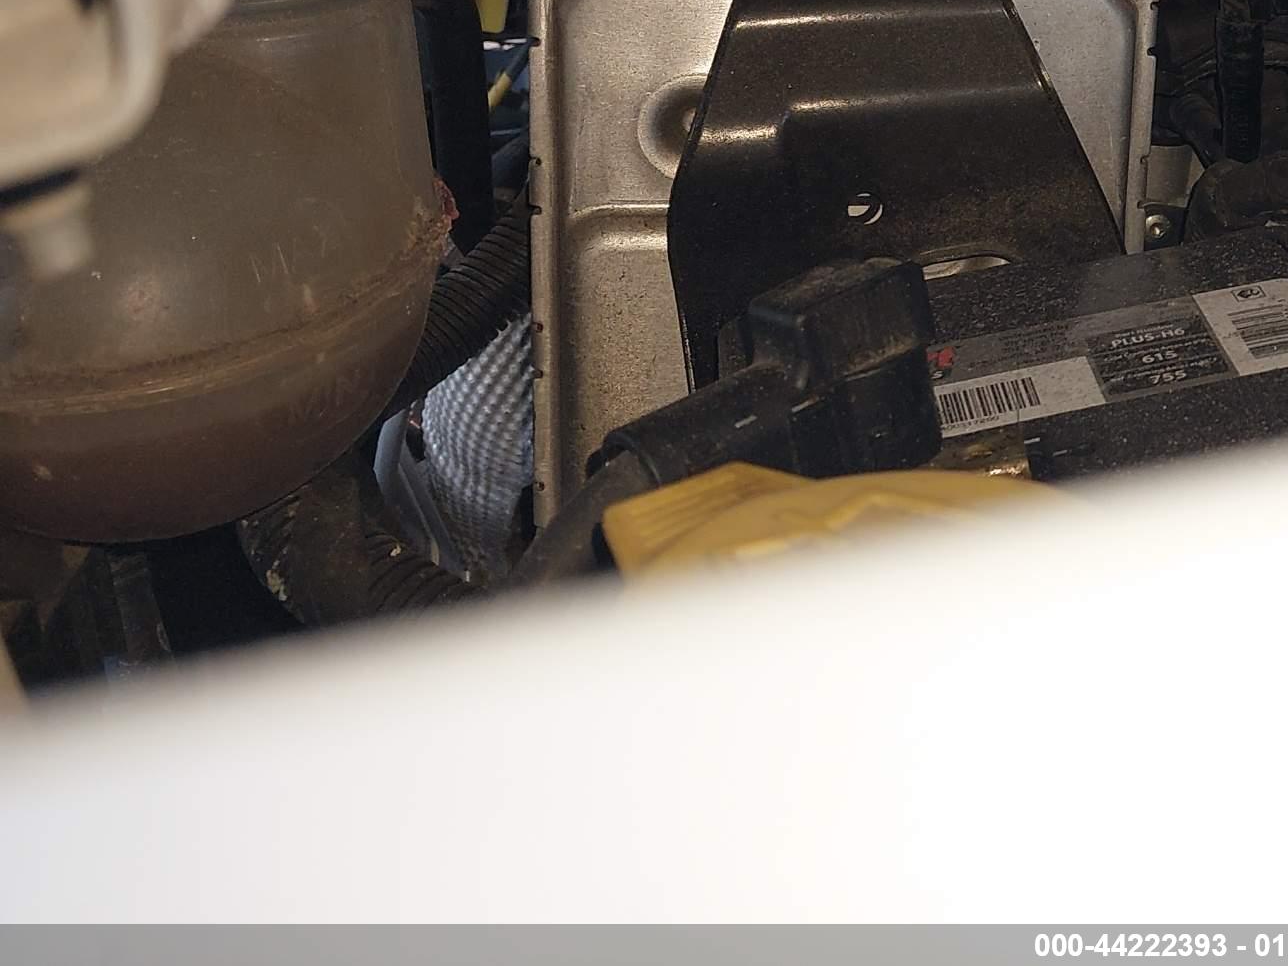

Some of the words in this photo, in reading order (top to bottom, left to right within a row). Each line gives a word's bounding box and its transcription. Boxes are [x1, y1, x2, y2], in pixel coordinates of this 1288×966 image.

[1110, 328, 1185, 349] PLUS-H6
[1141, 350, 1178, 364] 615
[1149, 369, 1187, 385] 755
